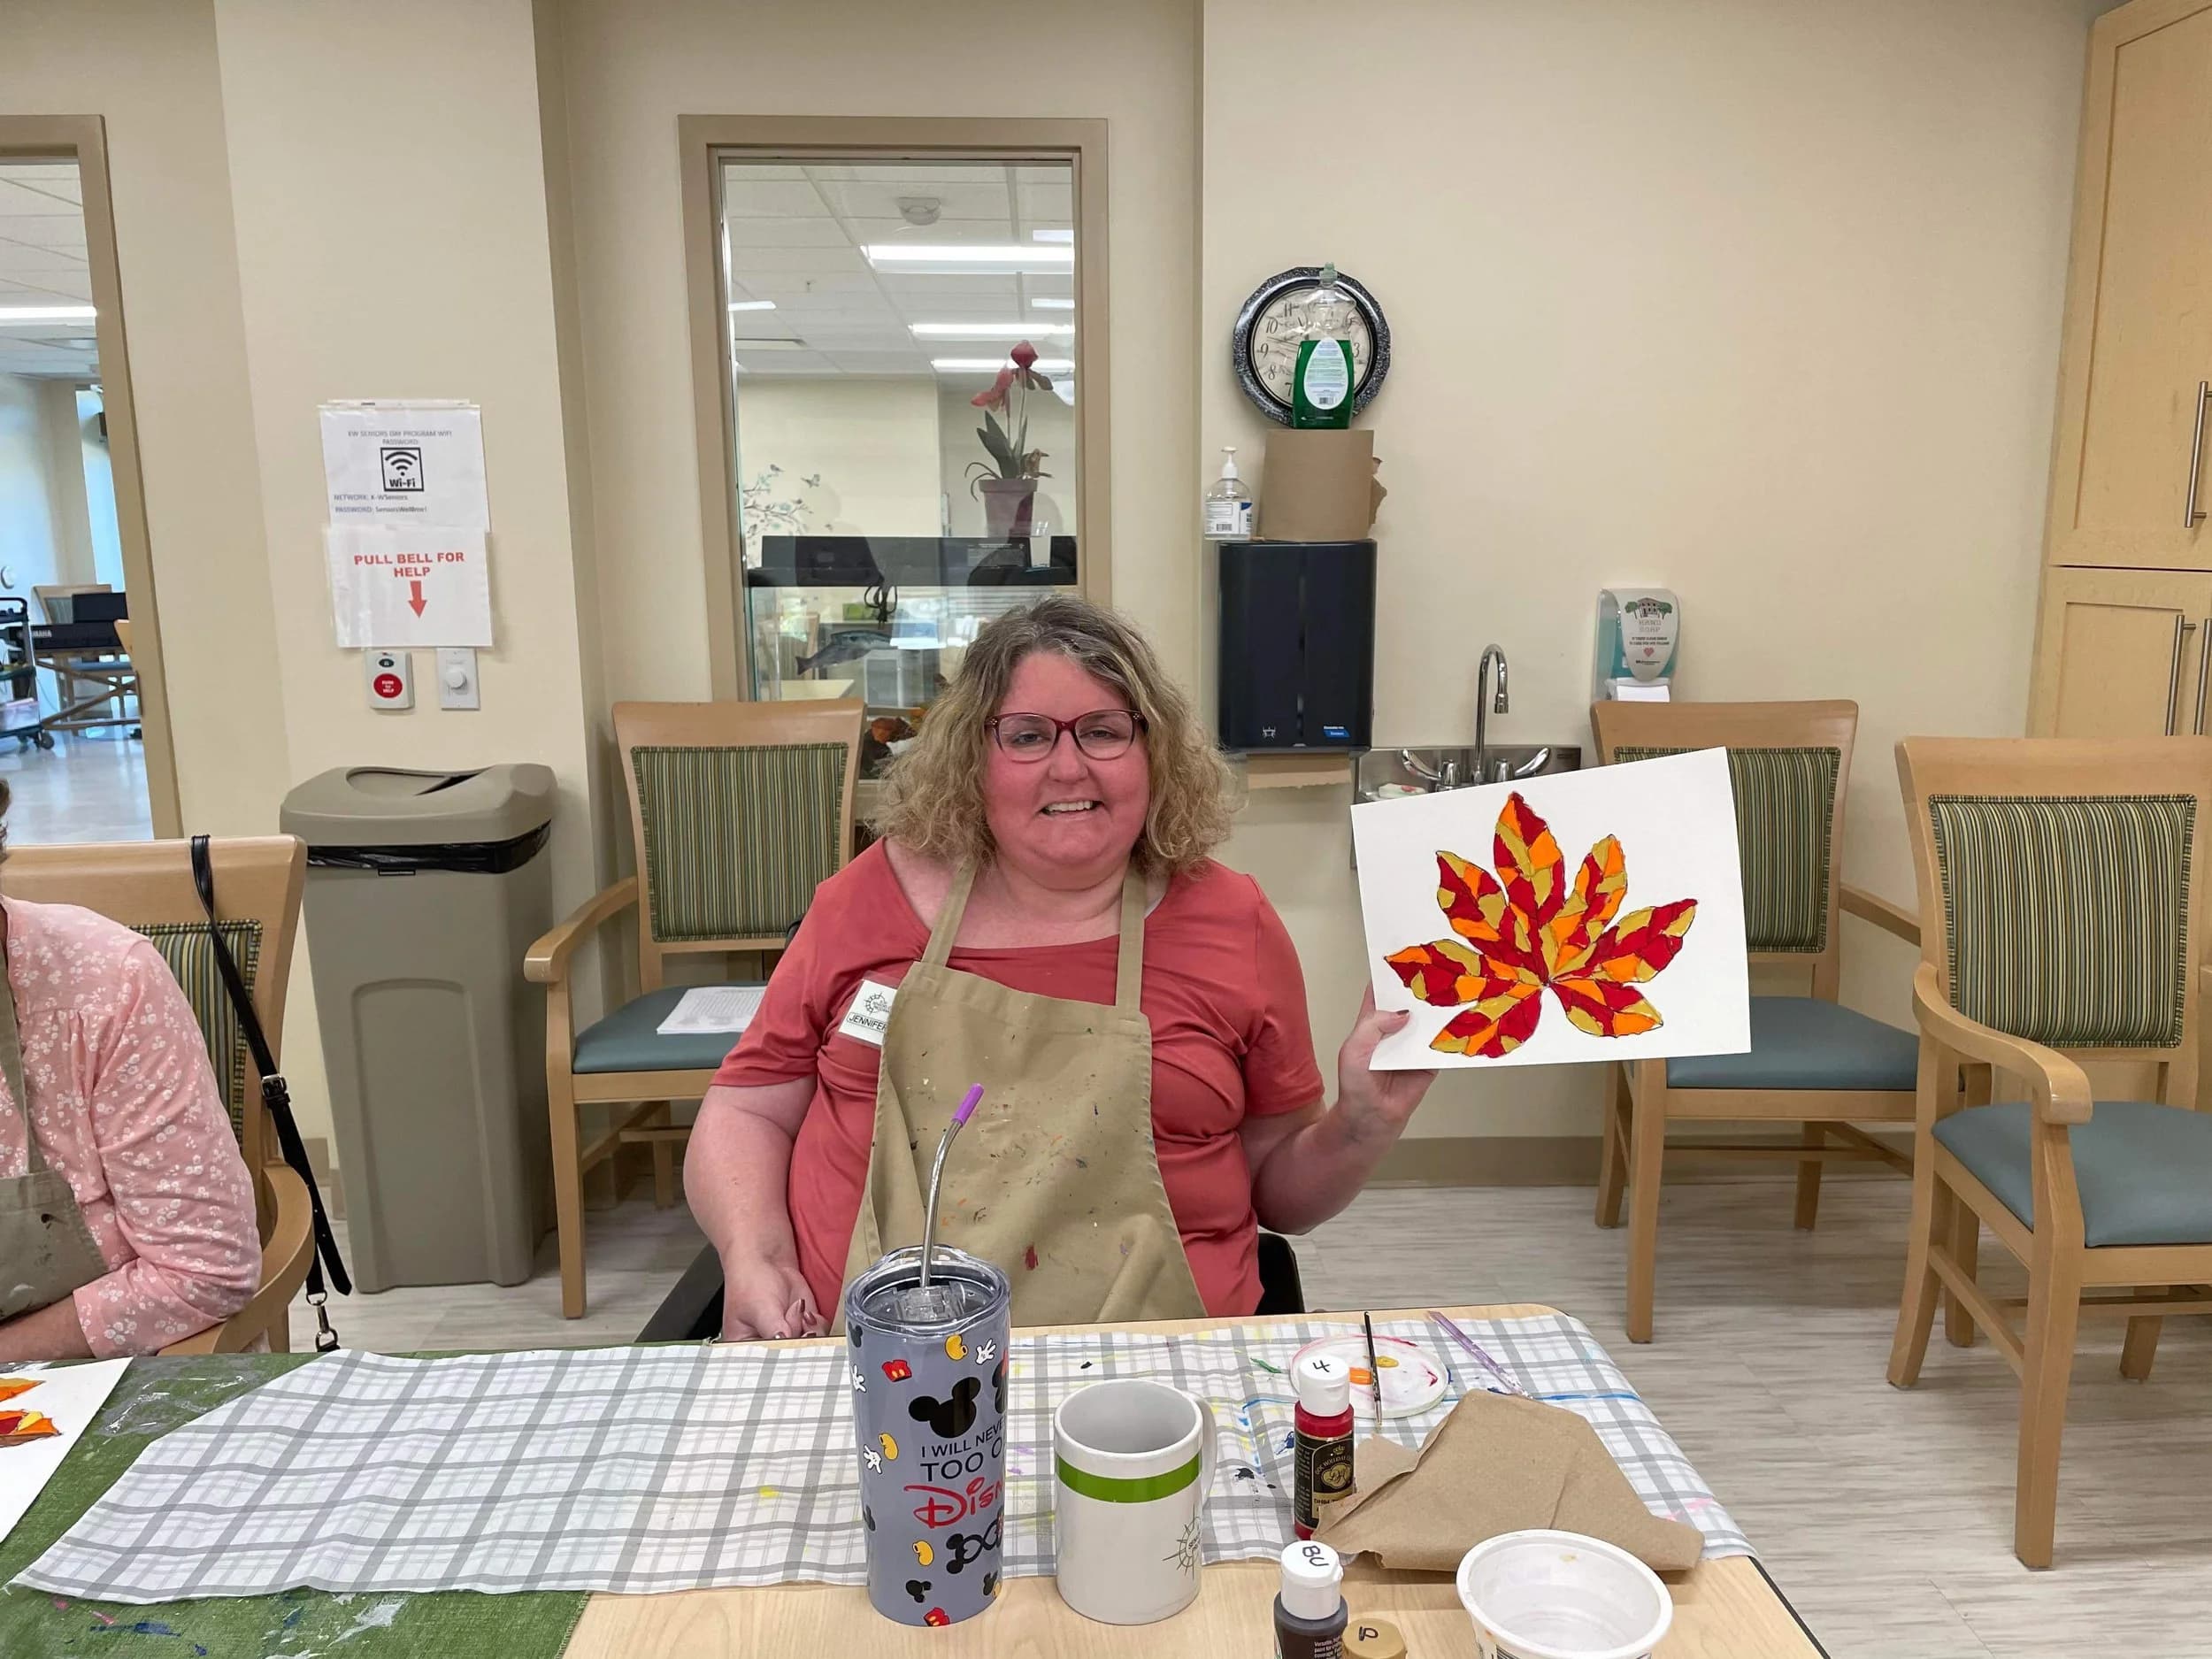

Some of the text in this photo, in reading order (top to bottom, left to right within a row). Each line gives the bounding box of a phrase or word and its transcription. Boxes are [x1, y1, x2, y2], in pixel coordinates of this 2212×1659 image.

[1266, 319, 1278, 334] 10
[1260, 342, 1269, 358] 9
[1353, 342, 1360, 357] 3
[1268, 365, 1276, 380] 8
[1285, 382, 1293, 396] 7
[389, 478, 416, 488] Wi-Fi
[354, 551, 465, 565] PULL BELL FOR
[394, 566, 431, 578] HELP
[922, 1446, 926, 1458] I
[931, 1440, 972, 1457] WILL
[920, 1452, 983, 1482] TOO
